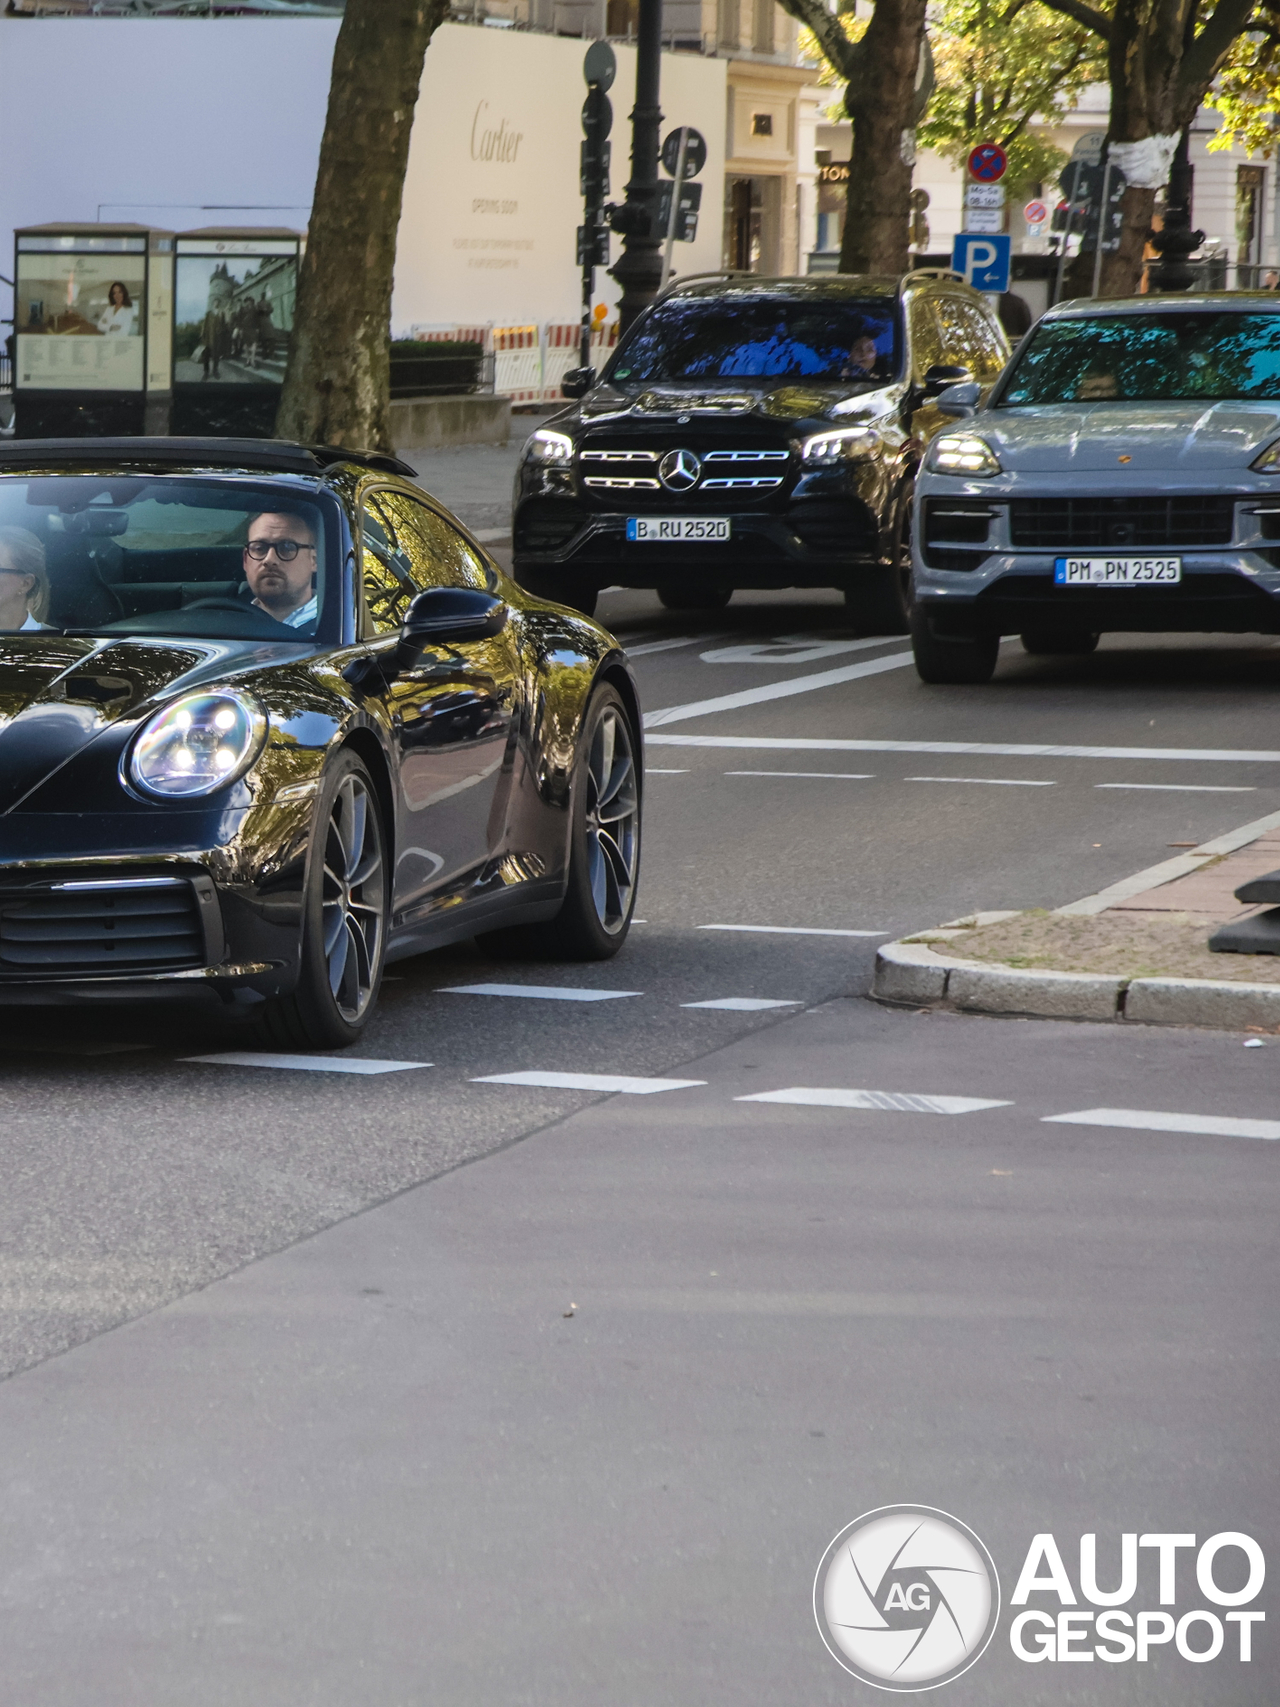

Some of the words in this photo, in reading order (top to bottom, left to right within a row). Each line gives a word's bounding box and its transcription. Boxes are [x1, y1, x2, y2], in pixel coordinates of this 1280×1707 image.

[470, 99, 524, 163] Cartier
[966, 240, 997, 284] P
[637, 521, 648, 538] B
[659, 521, 681, 538] RU
[684, 521, 727, 538] 2520
[1068, 561, 1091, 580] PM
[1105, 561, 1128, 580] PN
[1132, 561, 1177, 580] 2525
